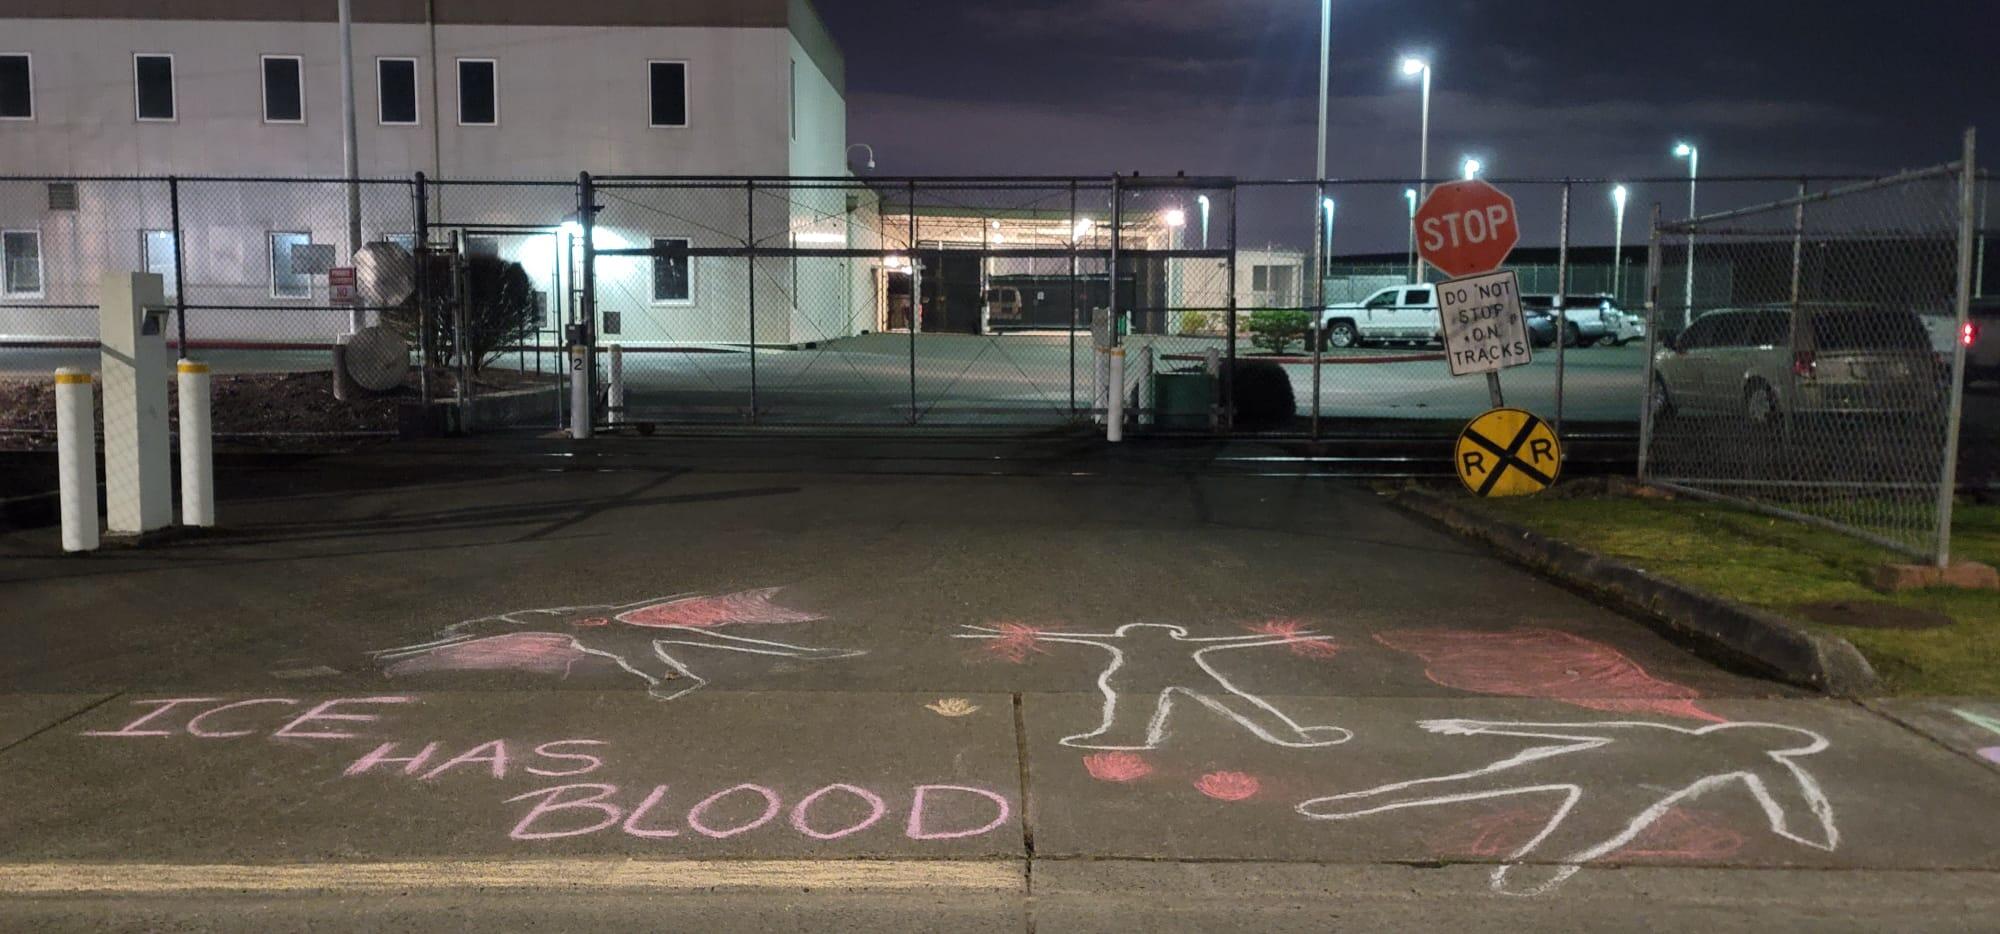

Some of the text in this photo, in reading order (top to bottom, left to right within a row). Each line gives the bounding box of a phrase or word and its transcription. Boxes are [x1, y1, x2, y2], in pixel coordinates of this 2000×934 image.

[1422, 204, 1508, 252] STOP
[1445, 281, 1511, 306] DO NOT
[1458, 303, 1504, 325] STOP
[1474, 326, 1499, 342] ON
[574, 358, 583, 371] 2
[1453, 341, 1525, 366] TRACKS
[1463, 438, 1554, 476] R R
[82, 696, 420, 738] ICE
[343, 739, 607, 780] HAS
[501, 782, 1011, 840] BLOOD
